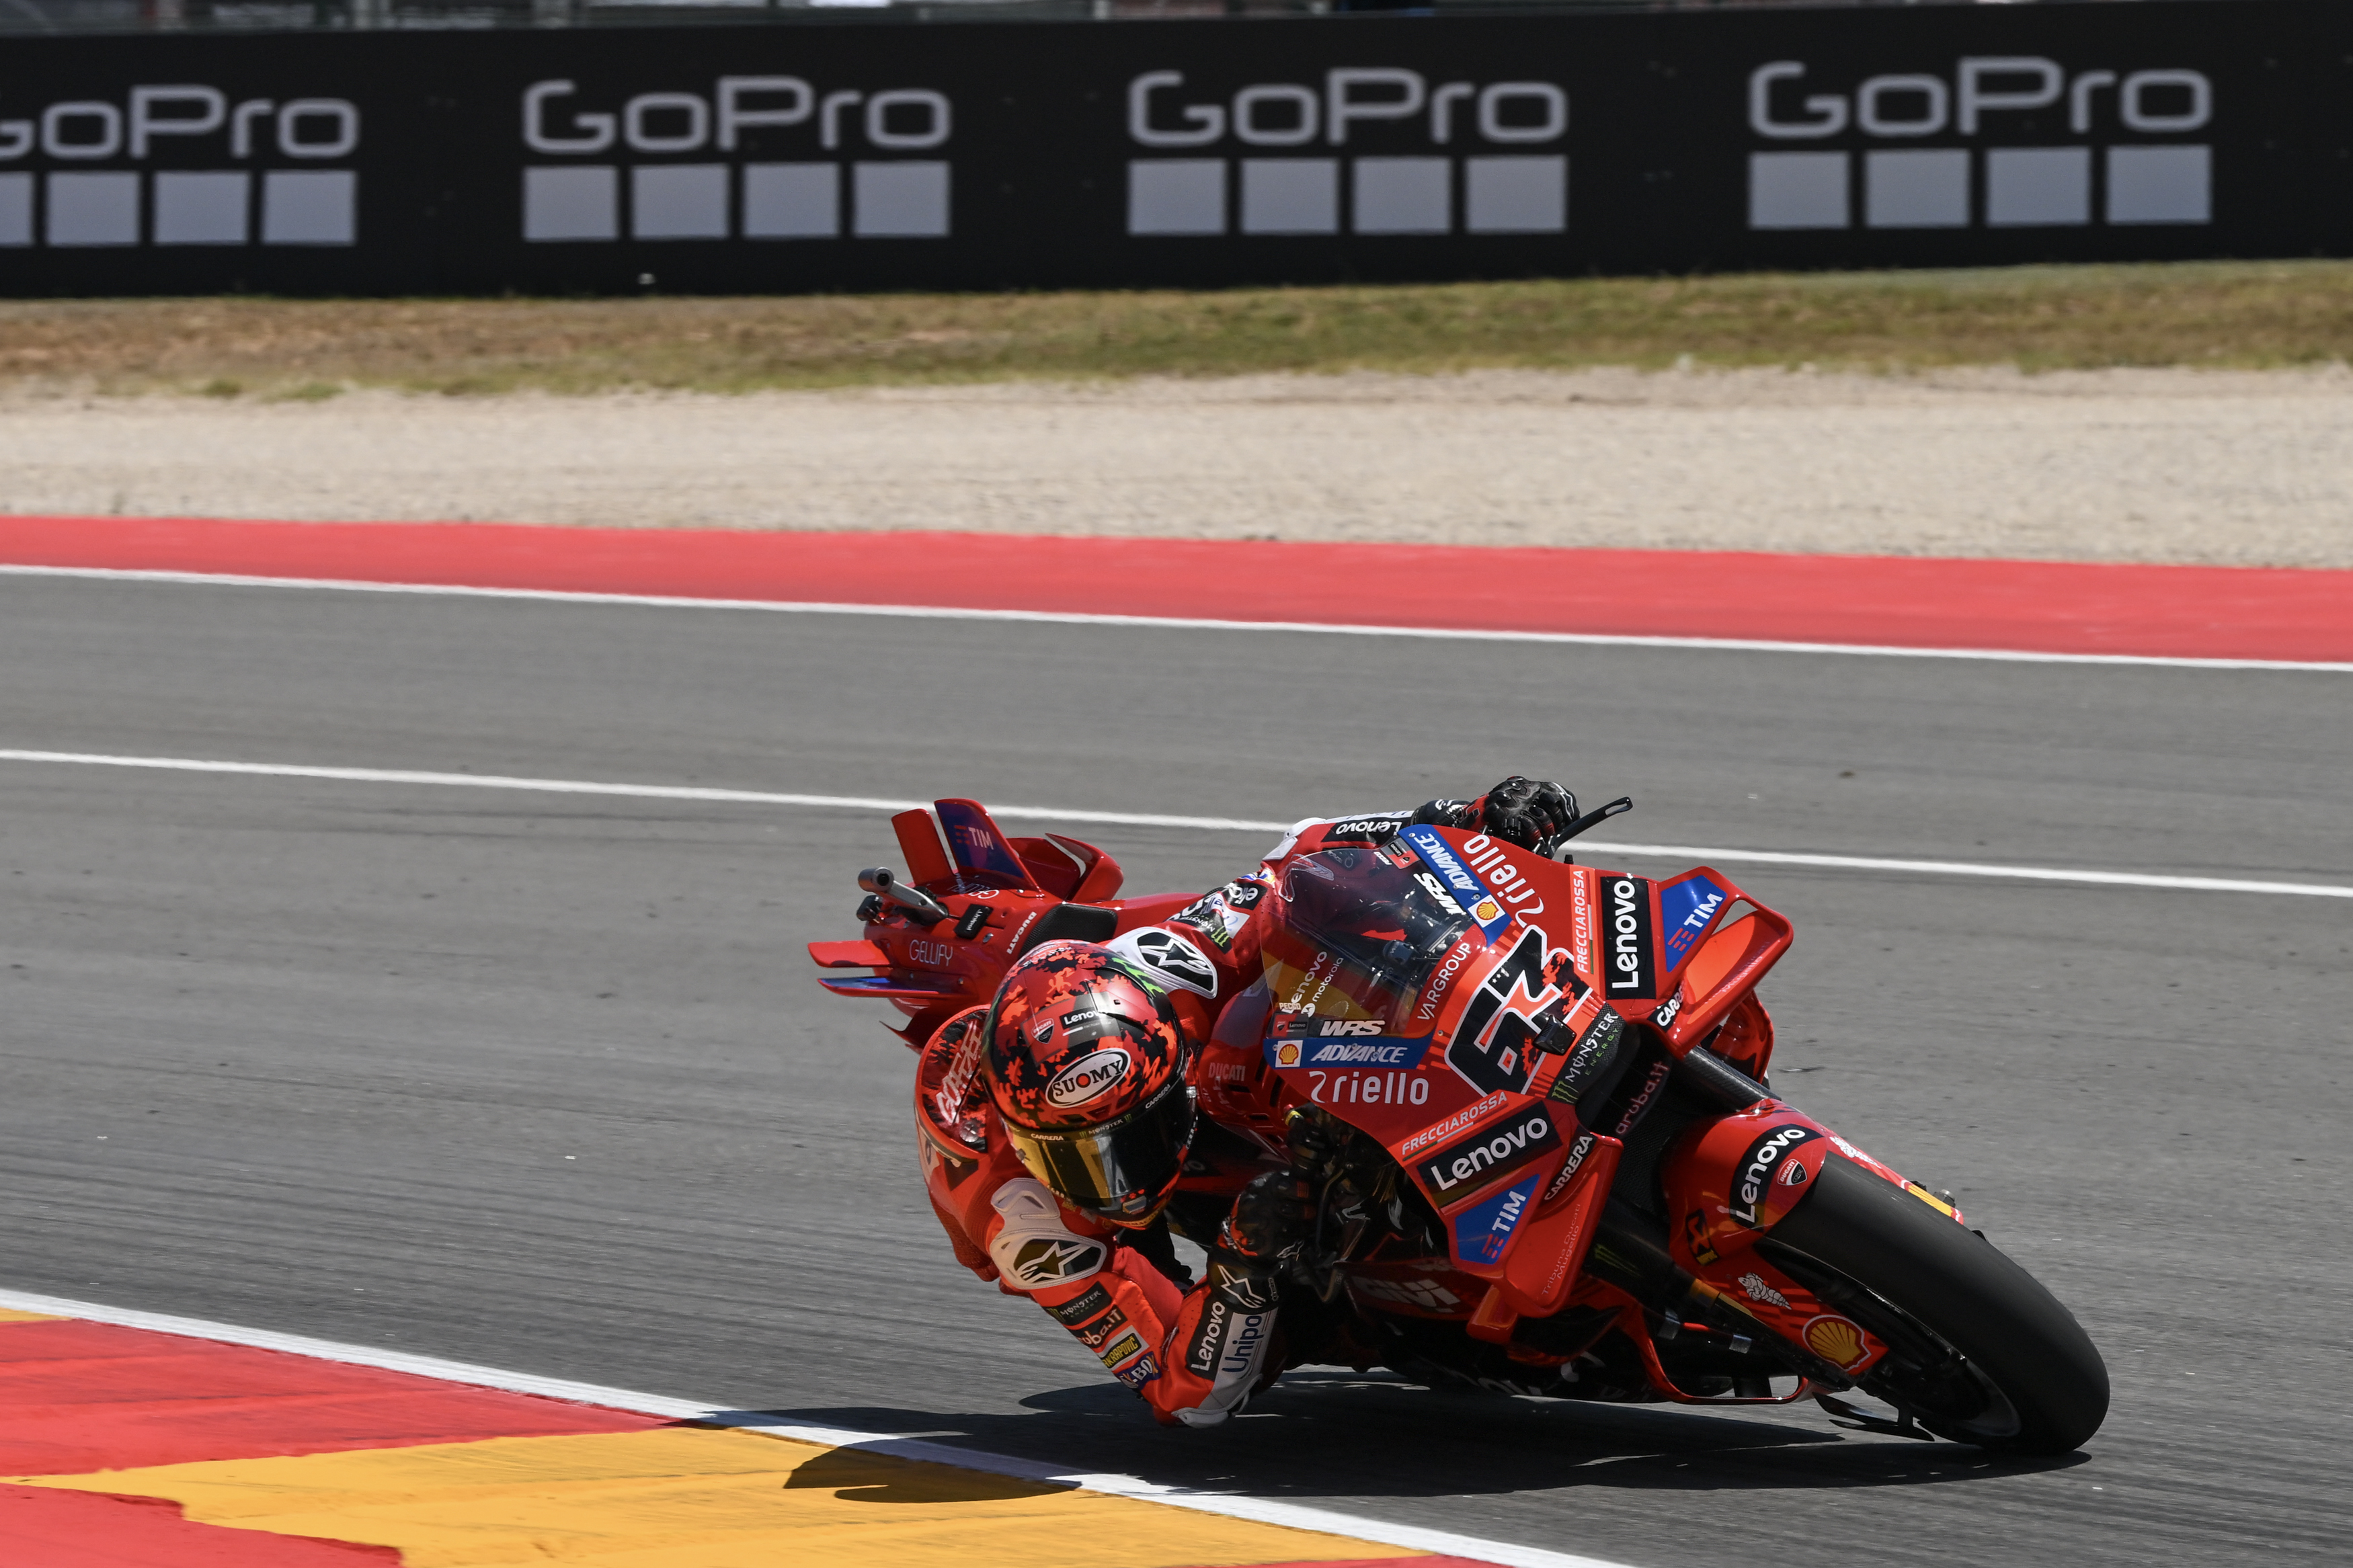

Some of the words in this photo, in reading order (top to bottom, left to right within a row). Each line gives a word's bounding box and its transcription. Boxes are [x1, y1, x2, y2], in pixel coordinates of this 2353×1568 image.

[523, 76, 951, 153] GoPro
[1128, 68, 1568, 147] GoPro
[1749, 56, 2212, 140] GoPro
[968, 827, 994, 850] TIM
[1335, 821, 1403, 836] Lenovo
[1414, 833, 1479, 891] ADVANCE
[1413, 872, 1468, 915] WRS
[1683, 893, 1723, 928] TIM
[1006, 911, 1037, 954] DUCATI
[1573, 870, 1589, 973] FRECCIAROSSA
[1611, 880, 1639, 989] Lenovo
[908, 939, 953, 966] GELLIFY
[1312, 957, 1345, 1003] motorola
[1319, 1020, 1386, 1036] WRS
[1444, 924, 1593, 1098] 63
[1208, 1062, 1246, 1081] DUCATI
[1310, 1044, 1408, 1063] ADVANCE
[1585, 1028, 1619, 1077] ENERGY
[1051, 1059, 1123, 1098] SUOMY
[1145, 1083, 1171, 1110] CARRERA
[1616, 1060, 1670, 1135] aruba.it
[1031, 1133, 1064, 1141] CARRERA
[1402, 1091, 1507, 1155] FRECCIAROSSA
[1430, 1118, 1548, 1191] Lenovo
[1544, 1134, 1593, 1200] CARRERA
[1737, 1128, 1806, 1227] Lenovo
[1780, 1161, 1795, 1182] DUCATI
[1491, 1190, 1527, 1233] TIM
[1556, 1225, 1579, 1279] Mugello
[1191, 1300, 1225, 1372] Lenovo
[1222, 1315, 1265, 1372] Unipo
